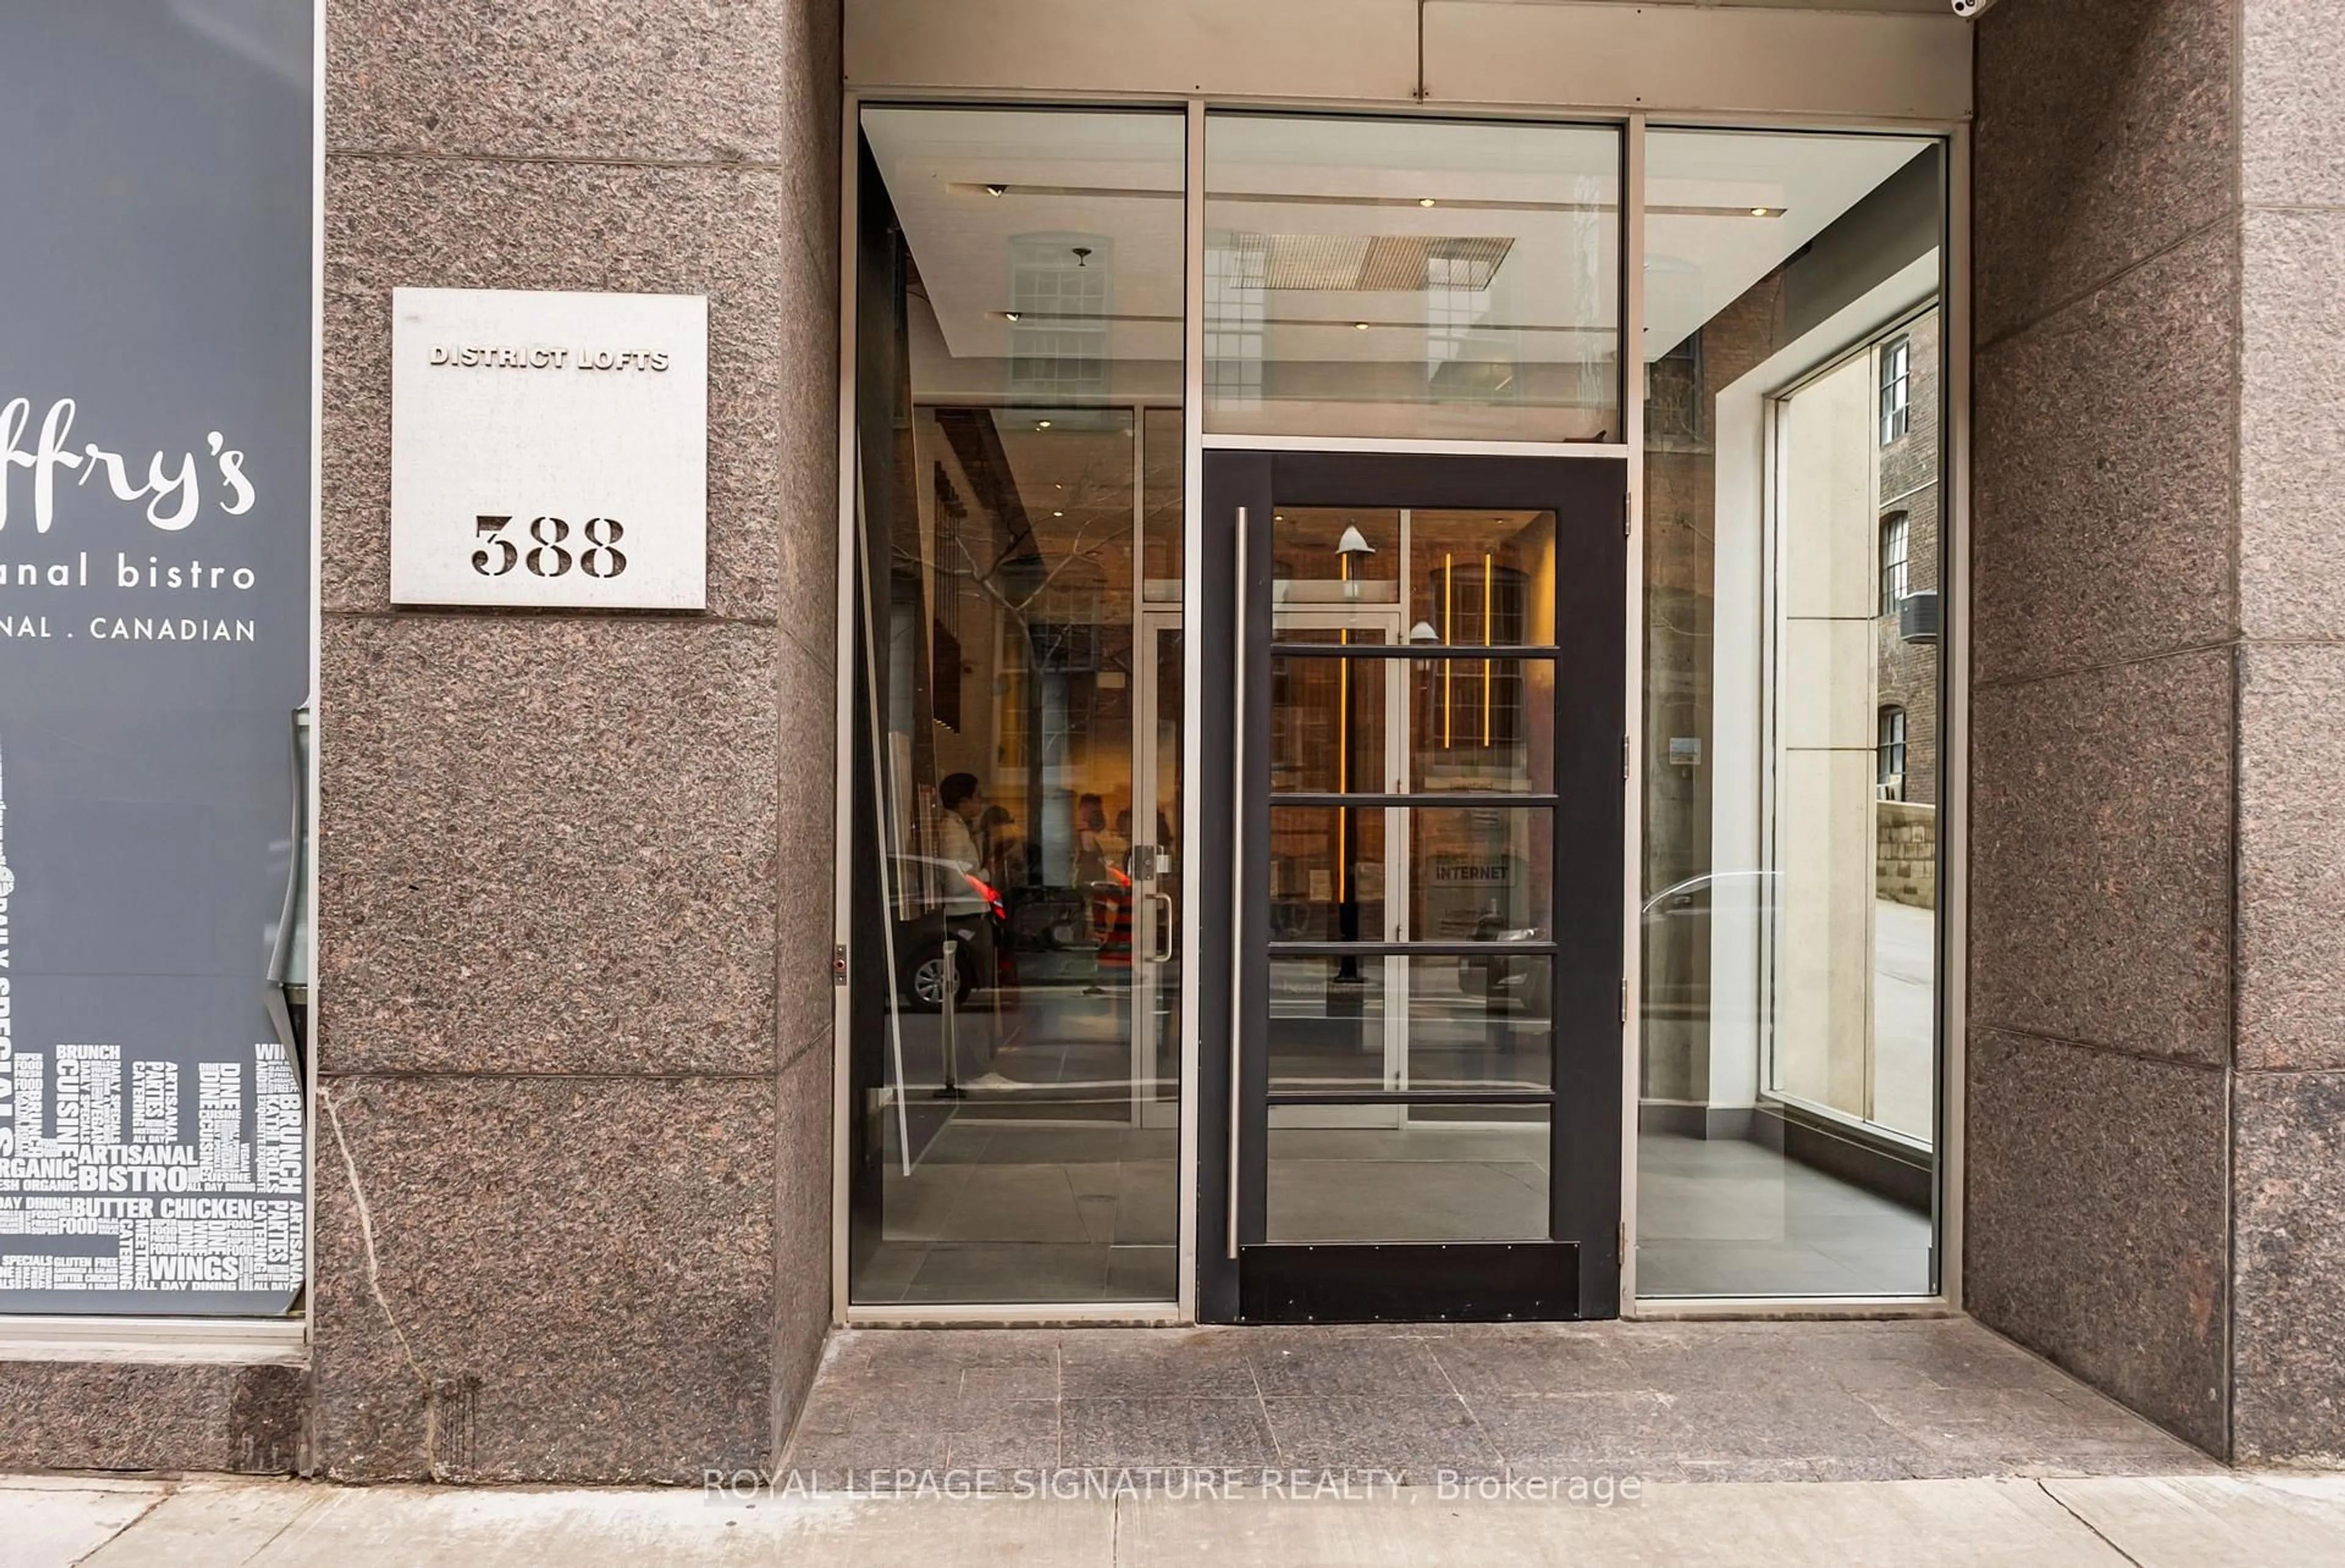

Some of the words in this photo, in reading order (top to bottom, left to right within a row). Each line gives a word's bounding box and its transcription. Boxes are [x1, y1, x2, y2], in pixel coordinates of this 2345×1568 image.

[430, 345, 568, 368] DISTRICT
[577, 347, 669, 371] LOFTS
[471, 515, 627, 578] 388
[0, 552, 87, 586] nal
[118, 552, 255, 589] bistro
[90, 617, 255, 641] CANADIAN
[1436, 866, 1508, 880] INTERNET
[56, 1045, 120, 1059] BRUNCH
[15, 1079, 43, 1090] FOOD
[80, 1061, 90, 1091] DAILY
[112, 1061, 121, 1091] DAILY
[145, 1061, 164, 1117] PARTIES
[200, 1071, 220, 1109] DINE
[220, 1063, 241, 1109] DINE
[57, 1060, 79, 1157] CUISINE
[133, 1061, 145, 1127] CATERING
[165, 1061, 178, 1144] ARTISANAL
[28, 1091, 42, 1157] BRUNCH
[80, 1095, 90, 1144] SPECIALS
[92, 1100, 104, 1144] VEGAN
[111, 1095, 121, 1144] SPECIALS
[199, 1110, 242, 1119] CUISINE
[266, 1095, 280, 1141] KATHI
[79, 1145, 198, 1164] ARTISANAL
[200, 1120, 213, 1174] CUISINE
[241, 1143, 250, 1172] VEGAN
[280, 1094, 302, 1194] BRUNCH
[79, 1165, 188, 1191] BISTRO
[200, 1172, 251, 1182] CUISINE
[266, 1145, 280, 1193] ROLLS
[23, 1180, 78, 1191] ORGANIC
[187, 1183, 202, 1192] ALL
[205, 1183, 223, 1192] DAY
[26, 1197, 70, 1210] DINING
[32, 1210, 59, 1218] FOOD
[72, 1197, 153, 1218] BUTTER
[160, 1198, 252, 1219] CHICKEN
[59, 1218, 97, 1234] FOOD
[209, 1221, 226, 1255] DINE
[254, 1200, 267, 1273] CATERING
[267, 1200, 289, 1262] PARTIES
[2, 1255, 53, 1266] SPECIALS
[120, 1219, 133, 1290] CATERING
[135, 1220, 149, 1281] MEETING
[150, 1243, 177, 1254] FOOD
[227, 1244, 253, 1255] FOOD
[289, 1200, 304, 1292] ARTISANAL
[150, 1257, 238, 1280] WINGS
[134, 1282, 157, 1290] ALL
[161, 1282, 188, 1290] DAY
[192, 1282, 237, 1290] DINING
